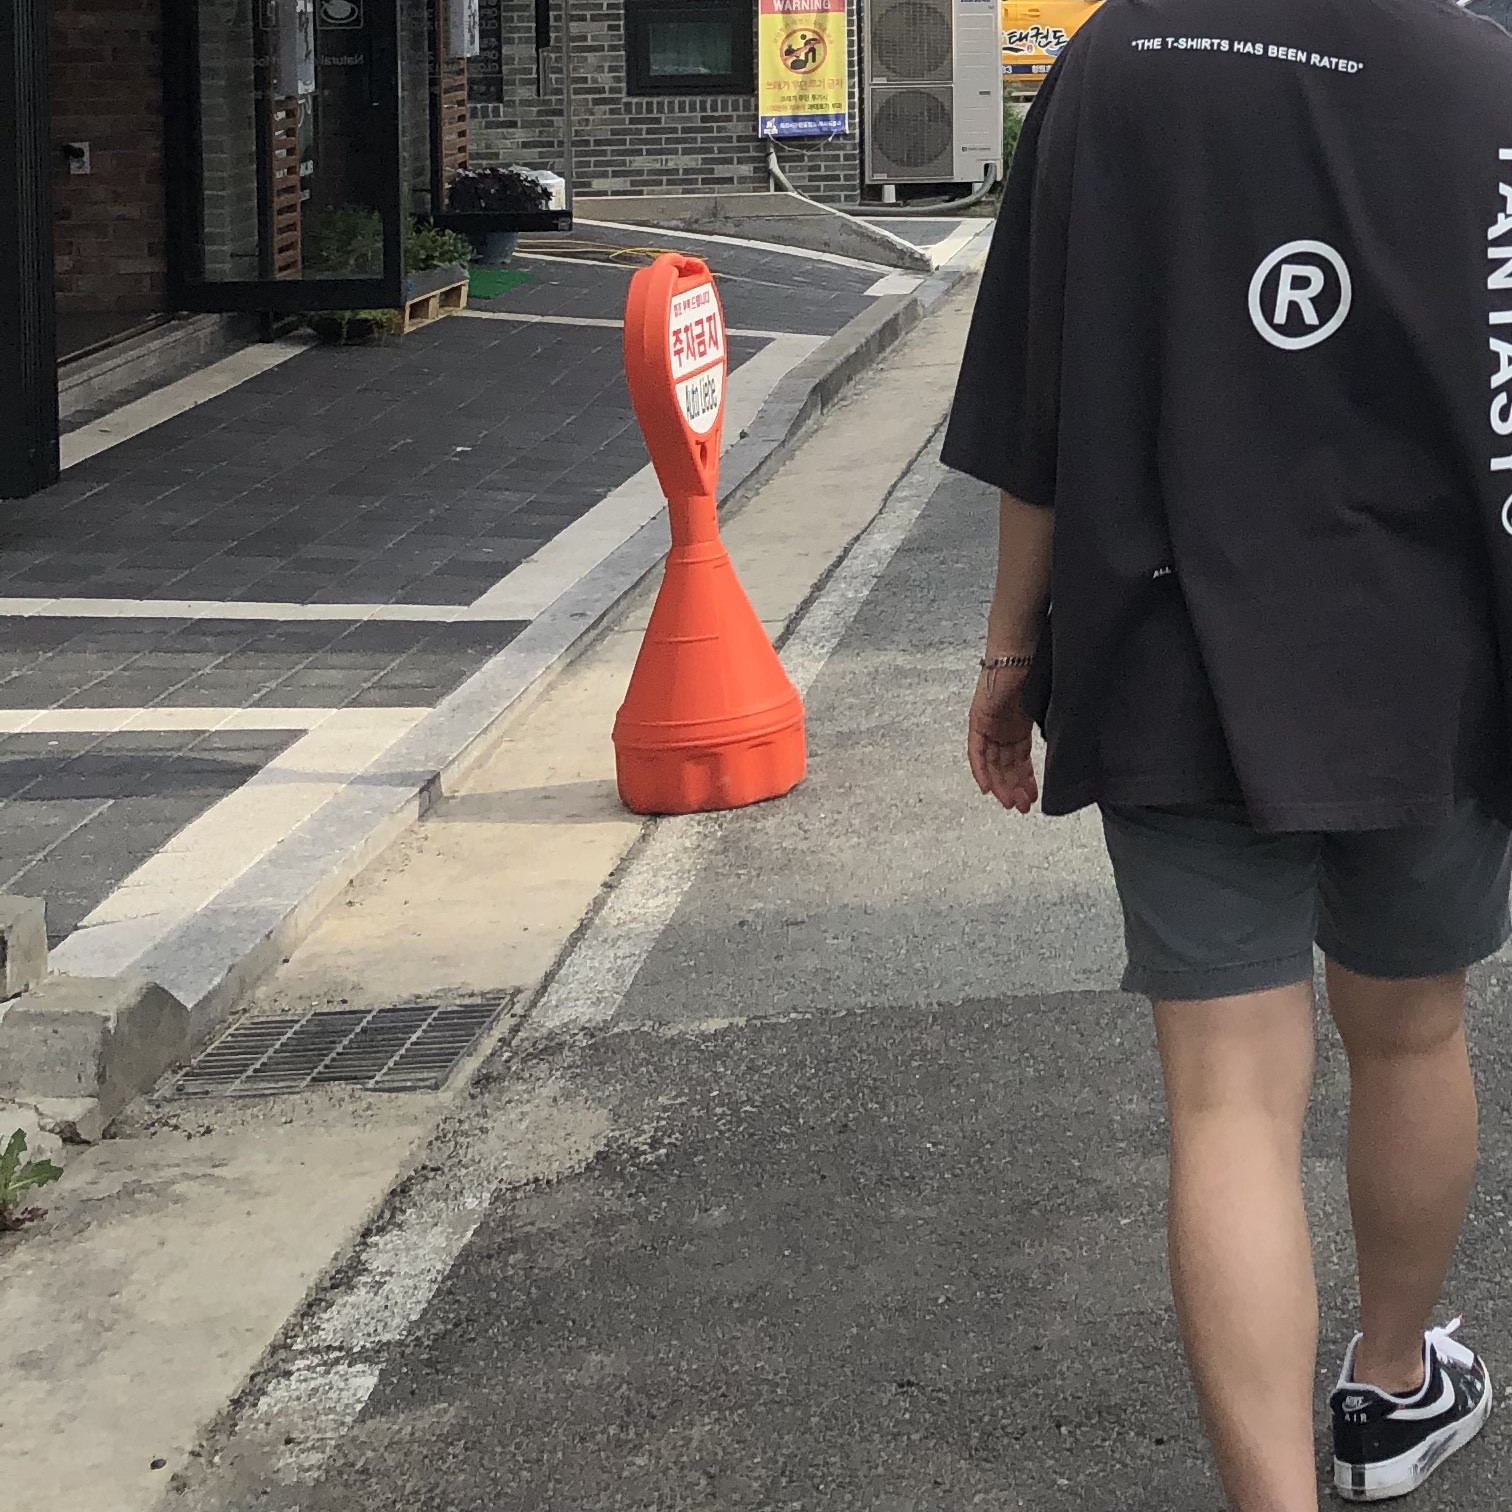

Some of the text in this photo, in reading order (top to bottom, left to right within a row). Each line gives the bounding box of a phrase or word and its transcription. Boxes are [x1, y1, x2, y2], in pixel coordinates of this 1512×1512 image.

[773, 0, 832, 11] WARNING
[1007, 26, 1069, 48] 태권도
[1166, 37, 1230, 52] T-SHIRTS
[1233, 40, 1264, 56] HAS
[1268, 44, 1307, 63] BEEN
[672, 312, 719, 368] 주차금지
[1344, 1412, 1367, 1423] AIR
